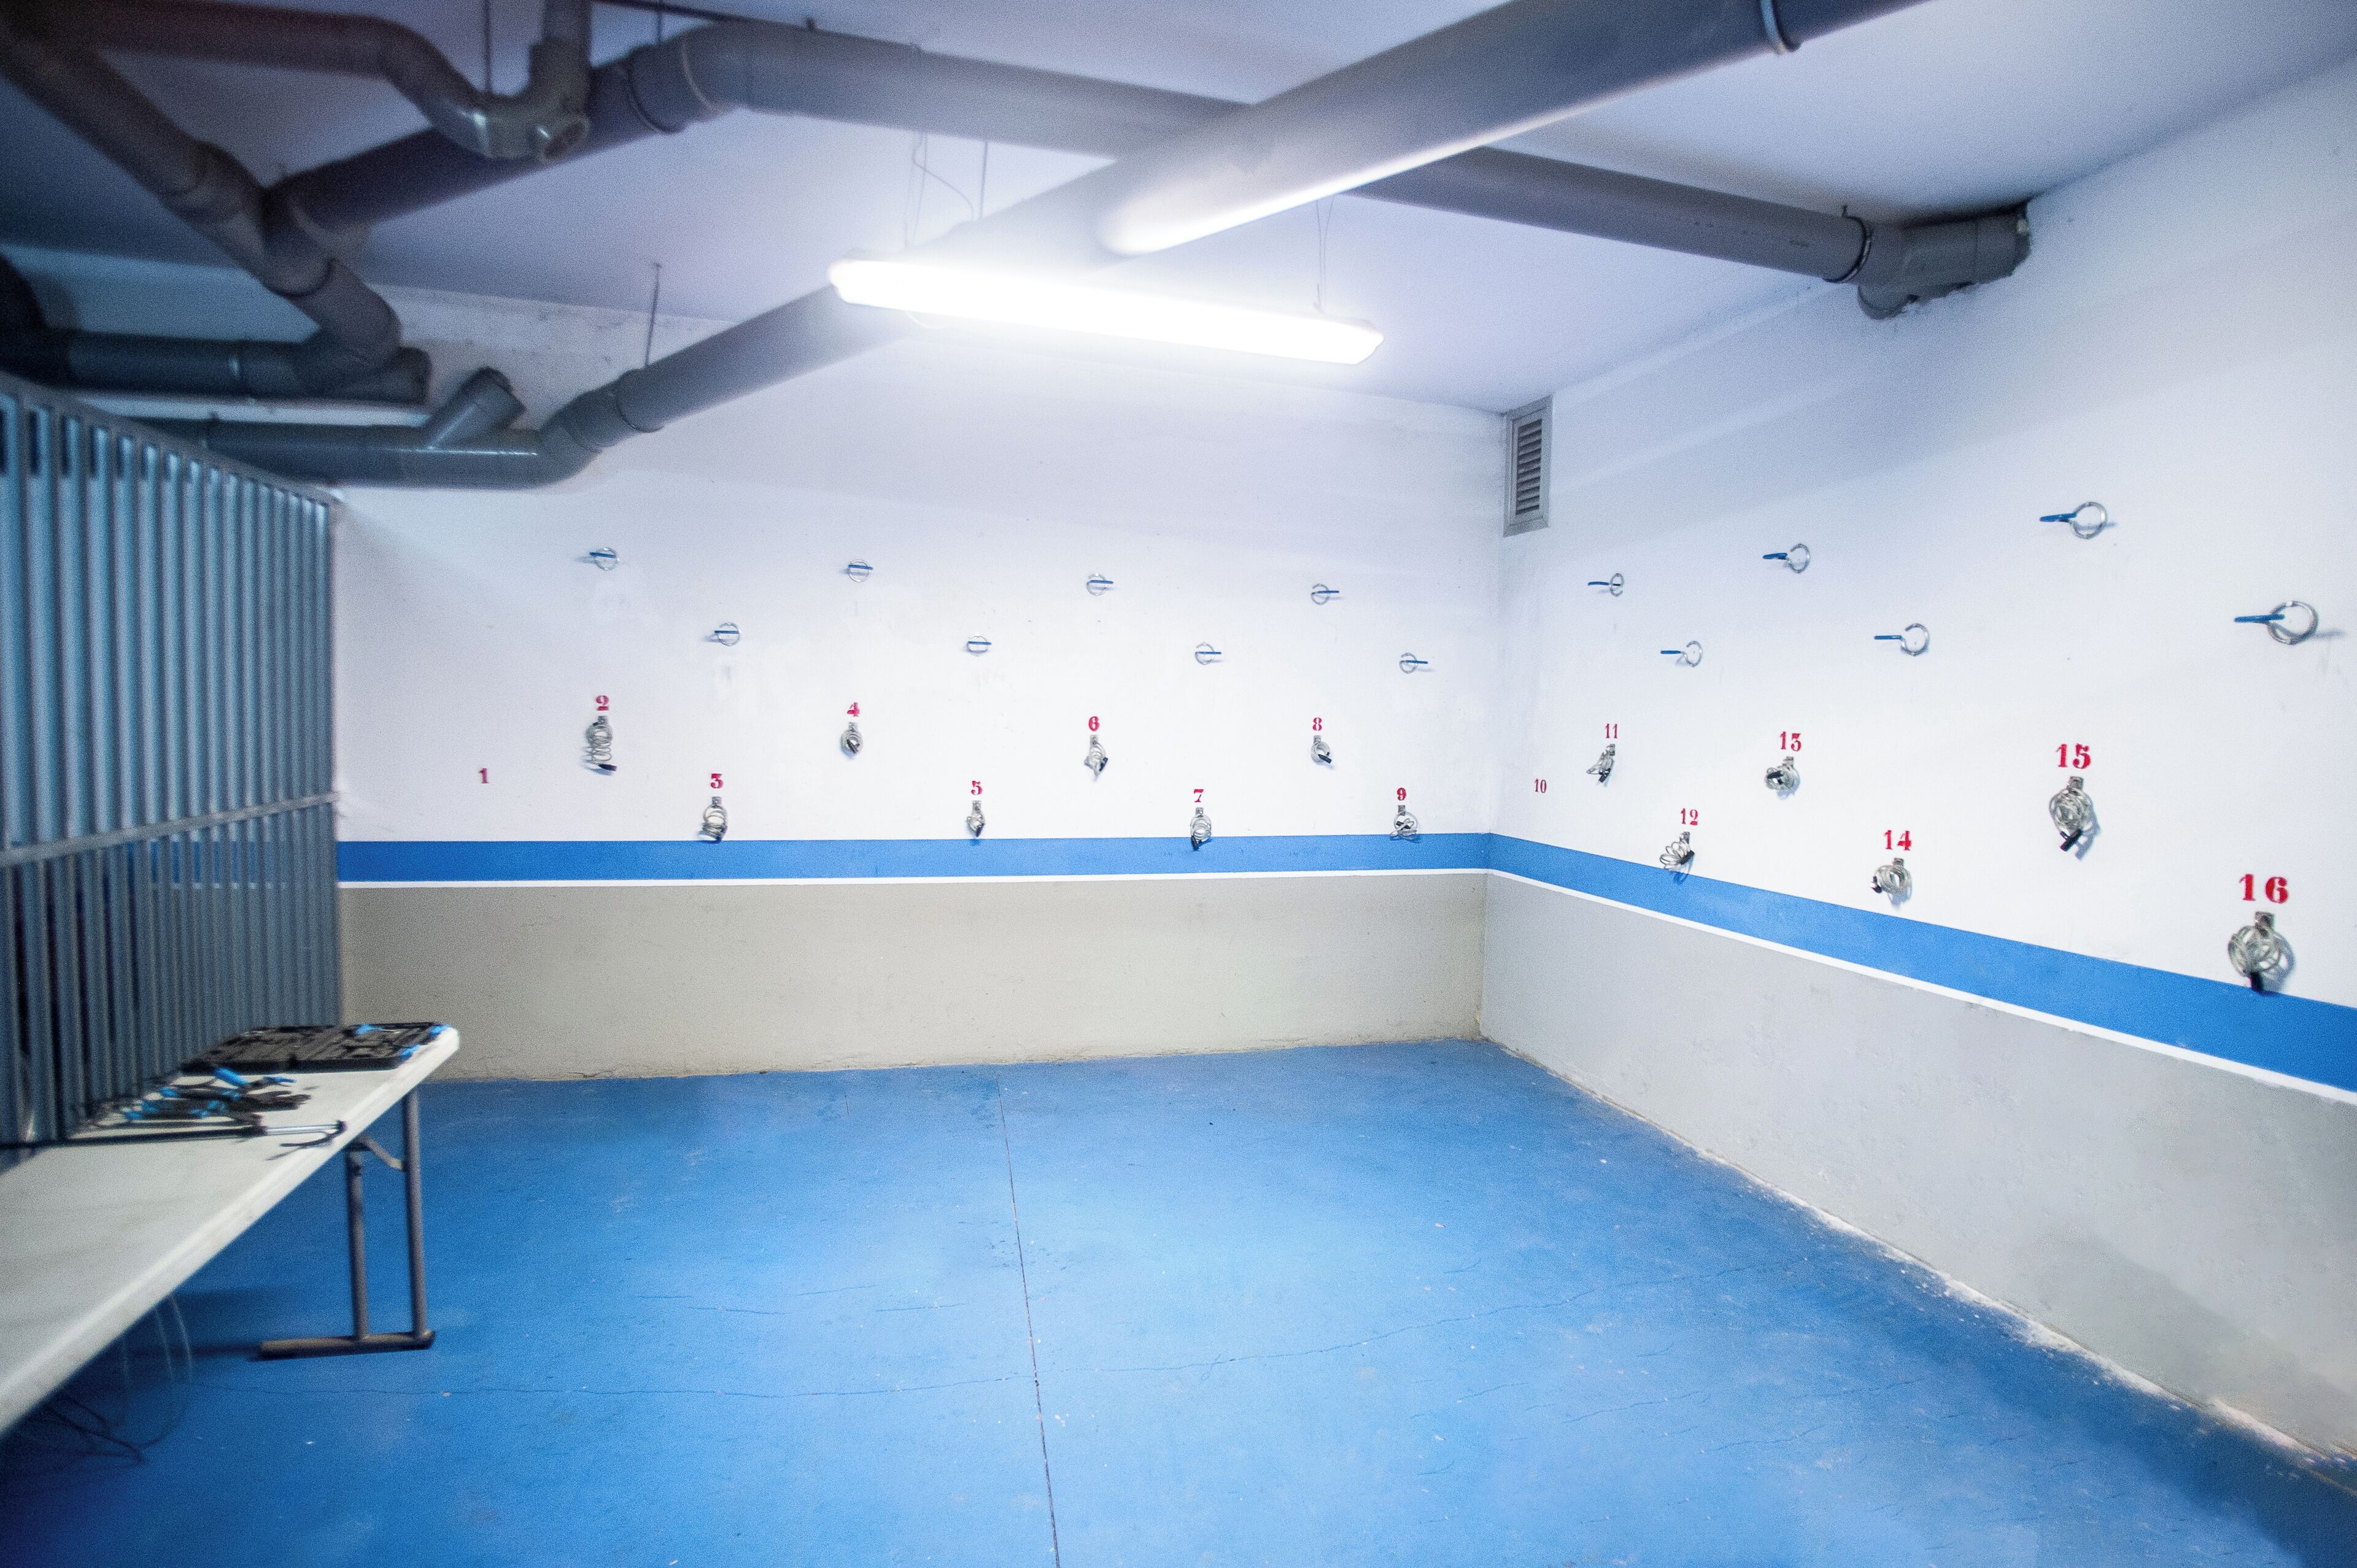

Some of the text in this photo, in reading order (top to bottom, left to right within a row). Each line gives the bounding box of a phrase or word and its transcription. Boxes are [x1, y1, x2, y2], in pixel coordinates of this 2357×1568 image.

[595, 695, 609, 711] 2
[846, 702, 860, 717] 4
[1088, 716, 1100, 732] 6
[1312, 717, 1323, 731] 8
[1606, 724, 1617, 739] 11
[1779, 732, 1802, 752] 13
[2056, 743, 2091, 770] 15
[479, 768, 489, 784] 1
[710, 773, 724, 789] 3
[971, 780, 982, 795] 5
[1396, 787, 1407, 801] 9
[1535, 779, 1547, 793] 10
[1193, 789, 1204, 803] 7
[1680, 808, 1698, 826] 12
[1884, 829, 1912, 851] 14
[2239, 873, 2288, 904] 16
